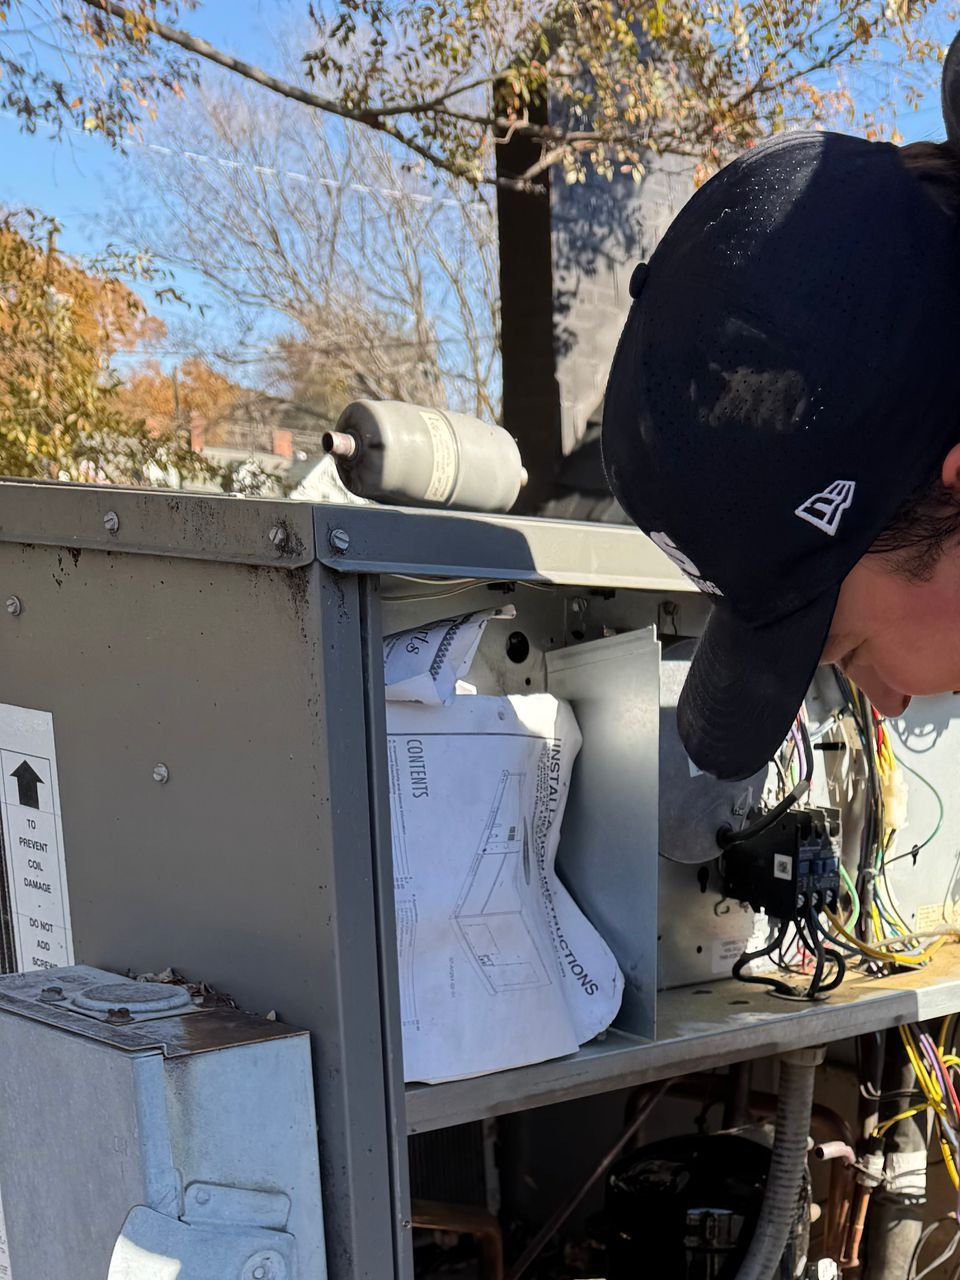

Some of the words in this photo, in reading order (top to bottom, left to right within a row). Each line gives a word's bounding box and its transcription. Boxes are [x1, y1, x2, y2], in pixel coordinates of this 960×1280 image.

[406, 738, 429, 799] CONTENTS
[26, 818, 36, 830] TO
[18, 836, 49, 854] PREVENT
[27, 859, 43, 872] COIL
[23, 877, 52, 894] DAMAGE
[29, 917, 39, 929] DO
[40, 920, 53, 933] NOT
[540, 873, 599, 997] INSTRUCTIONS
[37, 940, 50, 951] ADD
